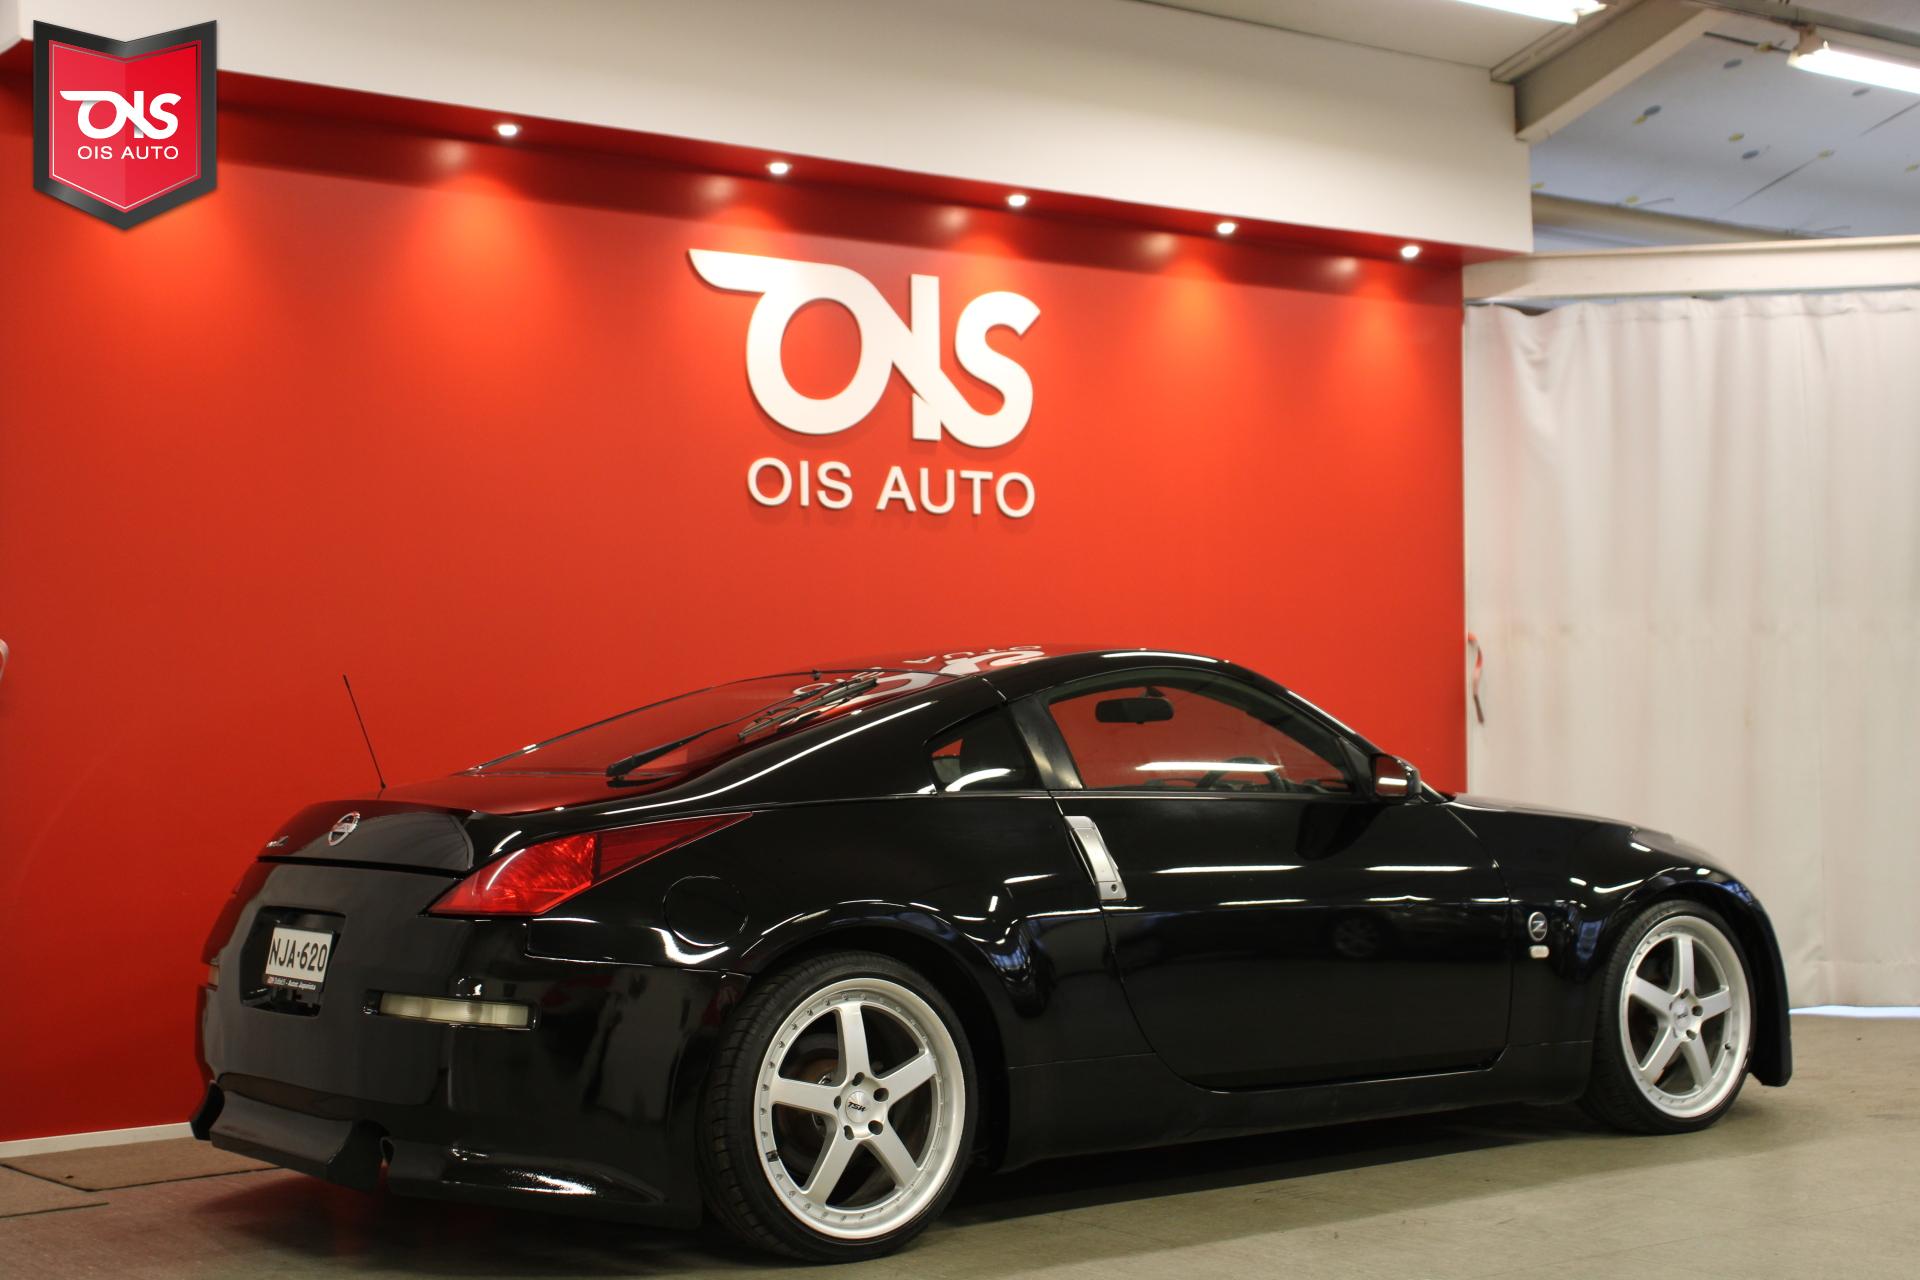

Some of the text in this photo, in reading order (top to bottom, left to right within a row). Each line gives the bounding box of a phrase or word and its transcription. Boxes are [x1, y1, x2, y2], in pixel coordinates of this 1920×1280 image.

[747, 457, 1035, 518] OIS AUTO
[268, 937, 328, 972] NJA-620
